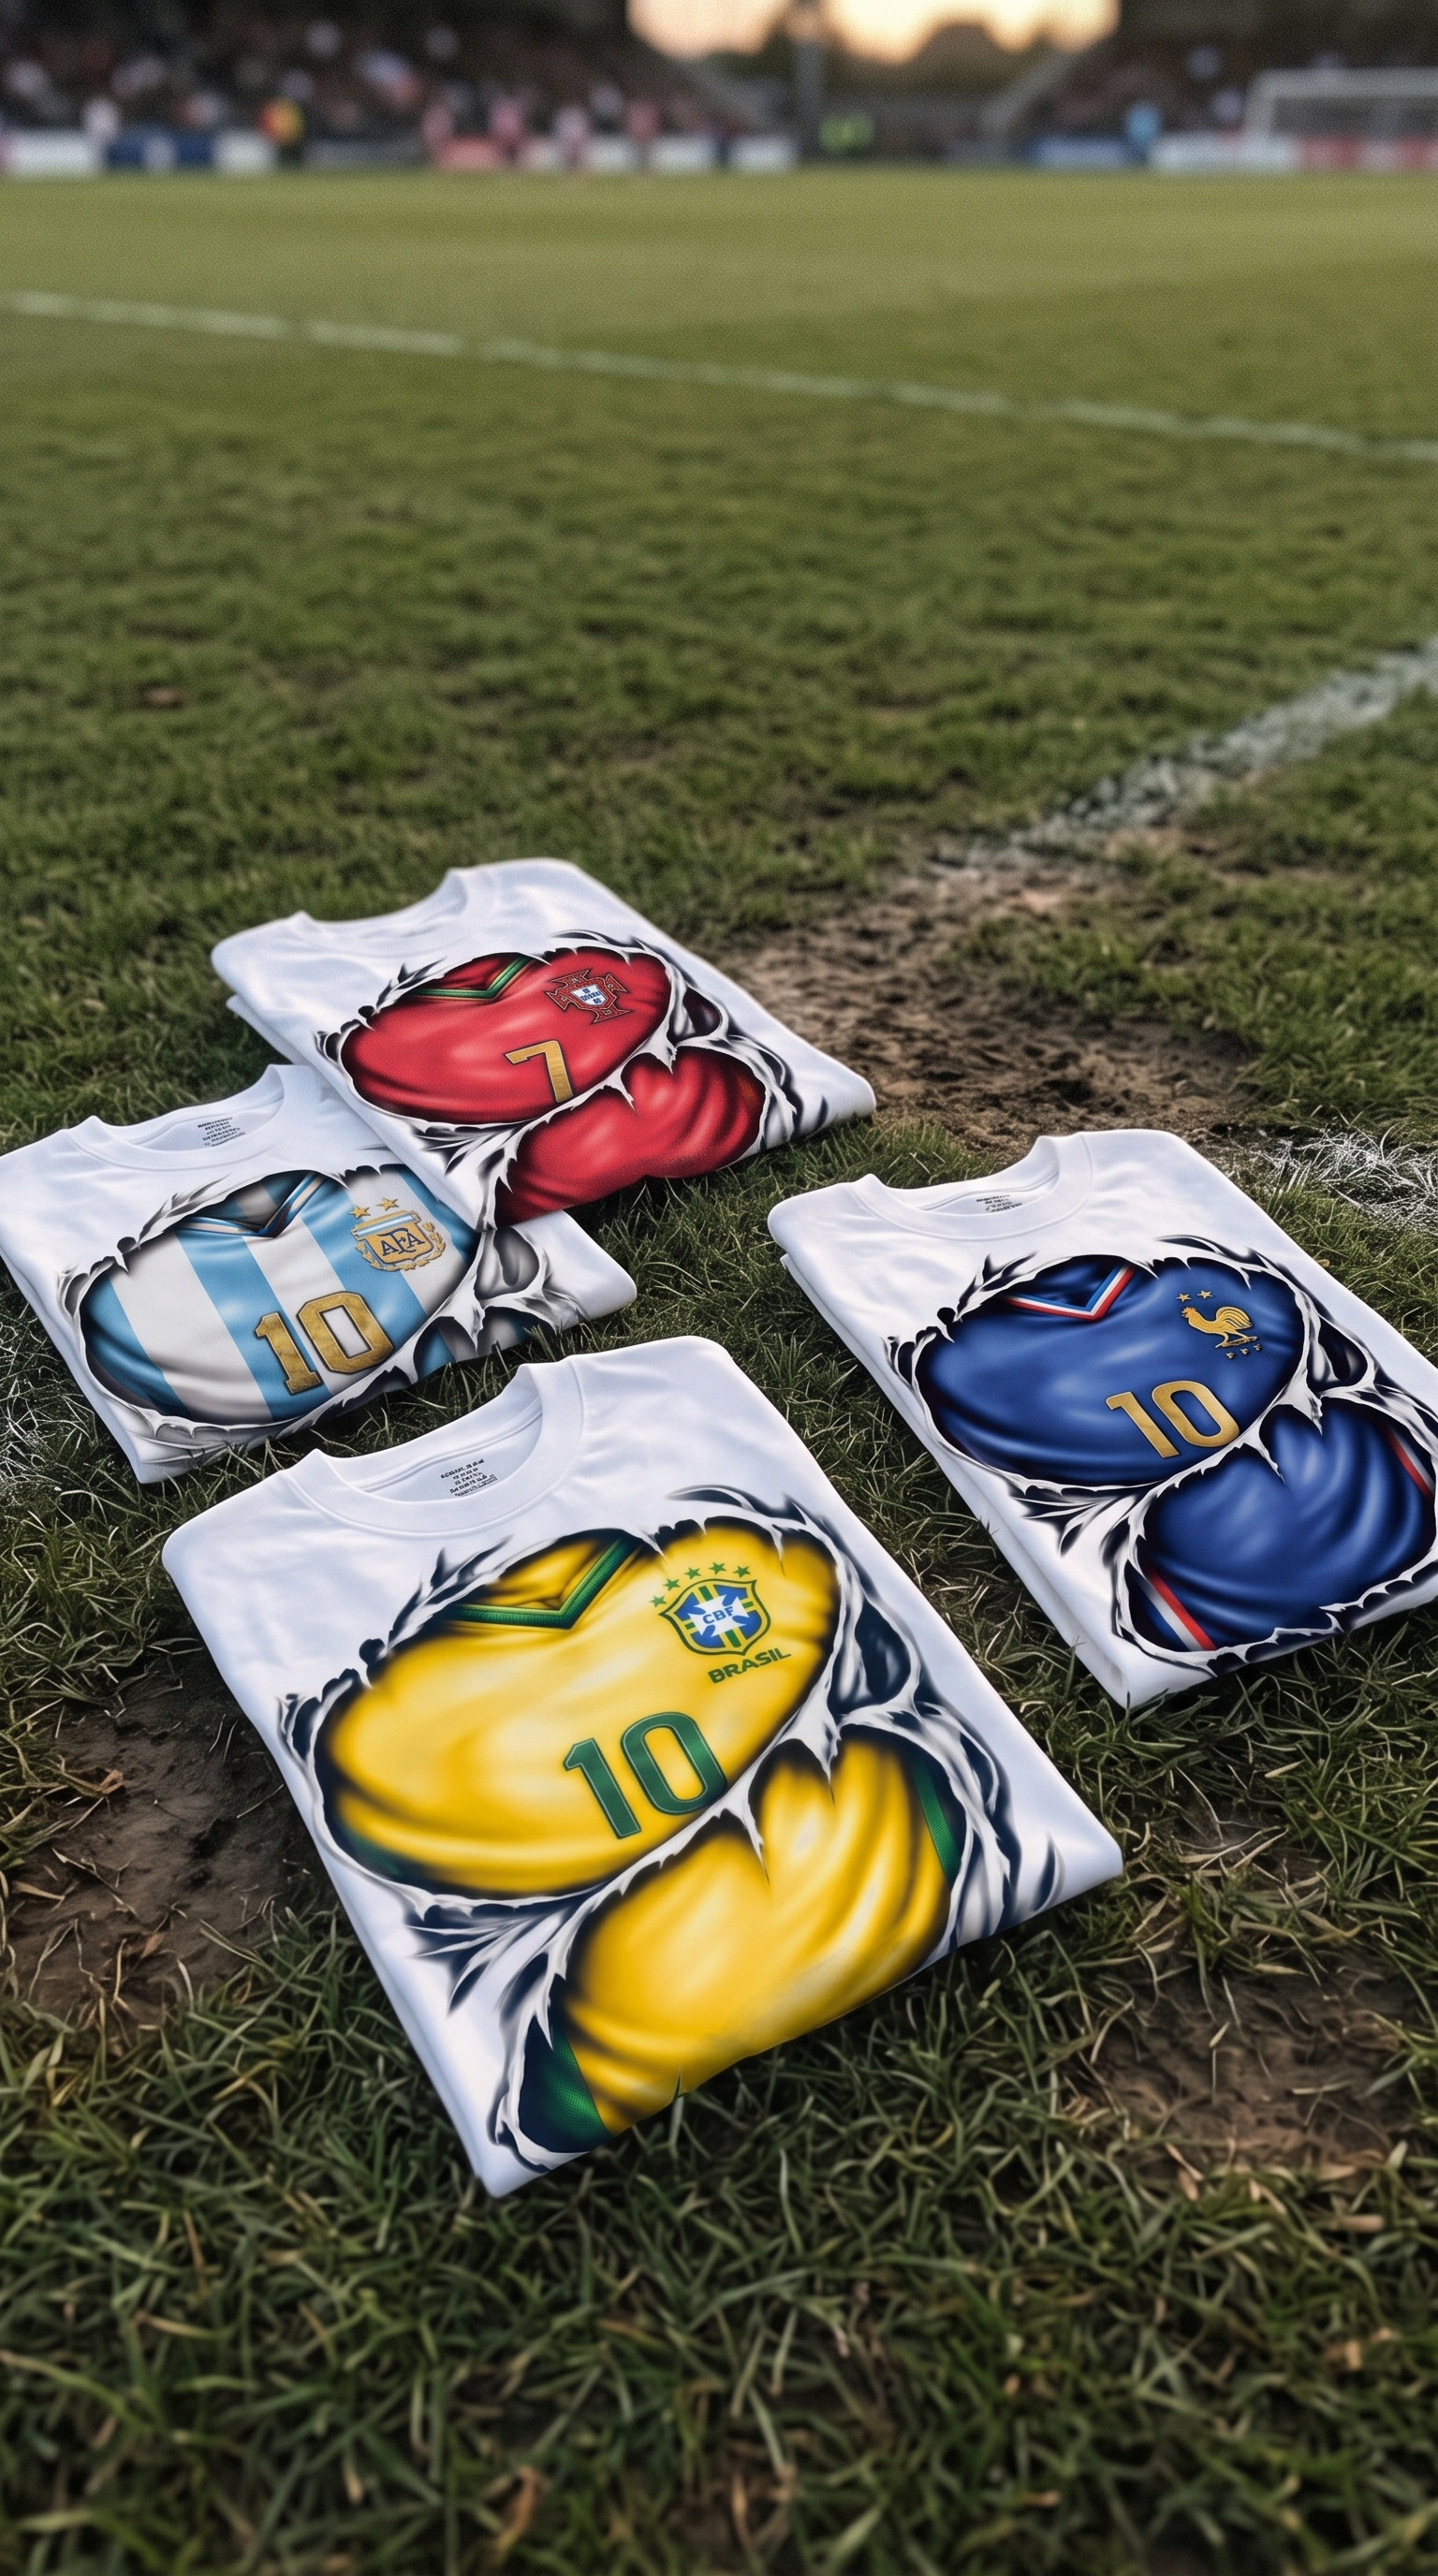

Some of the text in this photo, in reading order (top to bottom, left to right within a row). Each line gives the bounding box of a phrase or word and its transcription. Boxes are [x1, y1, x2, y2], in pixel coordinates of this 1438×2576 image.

[504, 1040, 574, 1103] 7
[376, 1227, 425, 1256] AFA
[254, 1291, 395, 1396] 10
[1106, 1381, 1240, 1458] 10
[702, 1606, 734, 1625] CBF
[708, 1648, 791, 1684] BRASIL
[563, 1711, 727, 1840] 10
